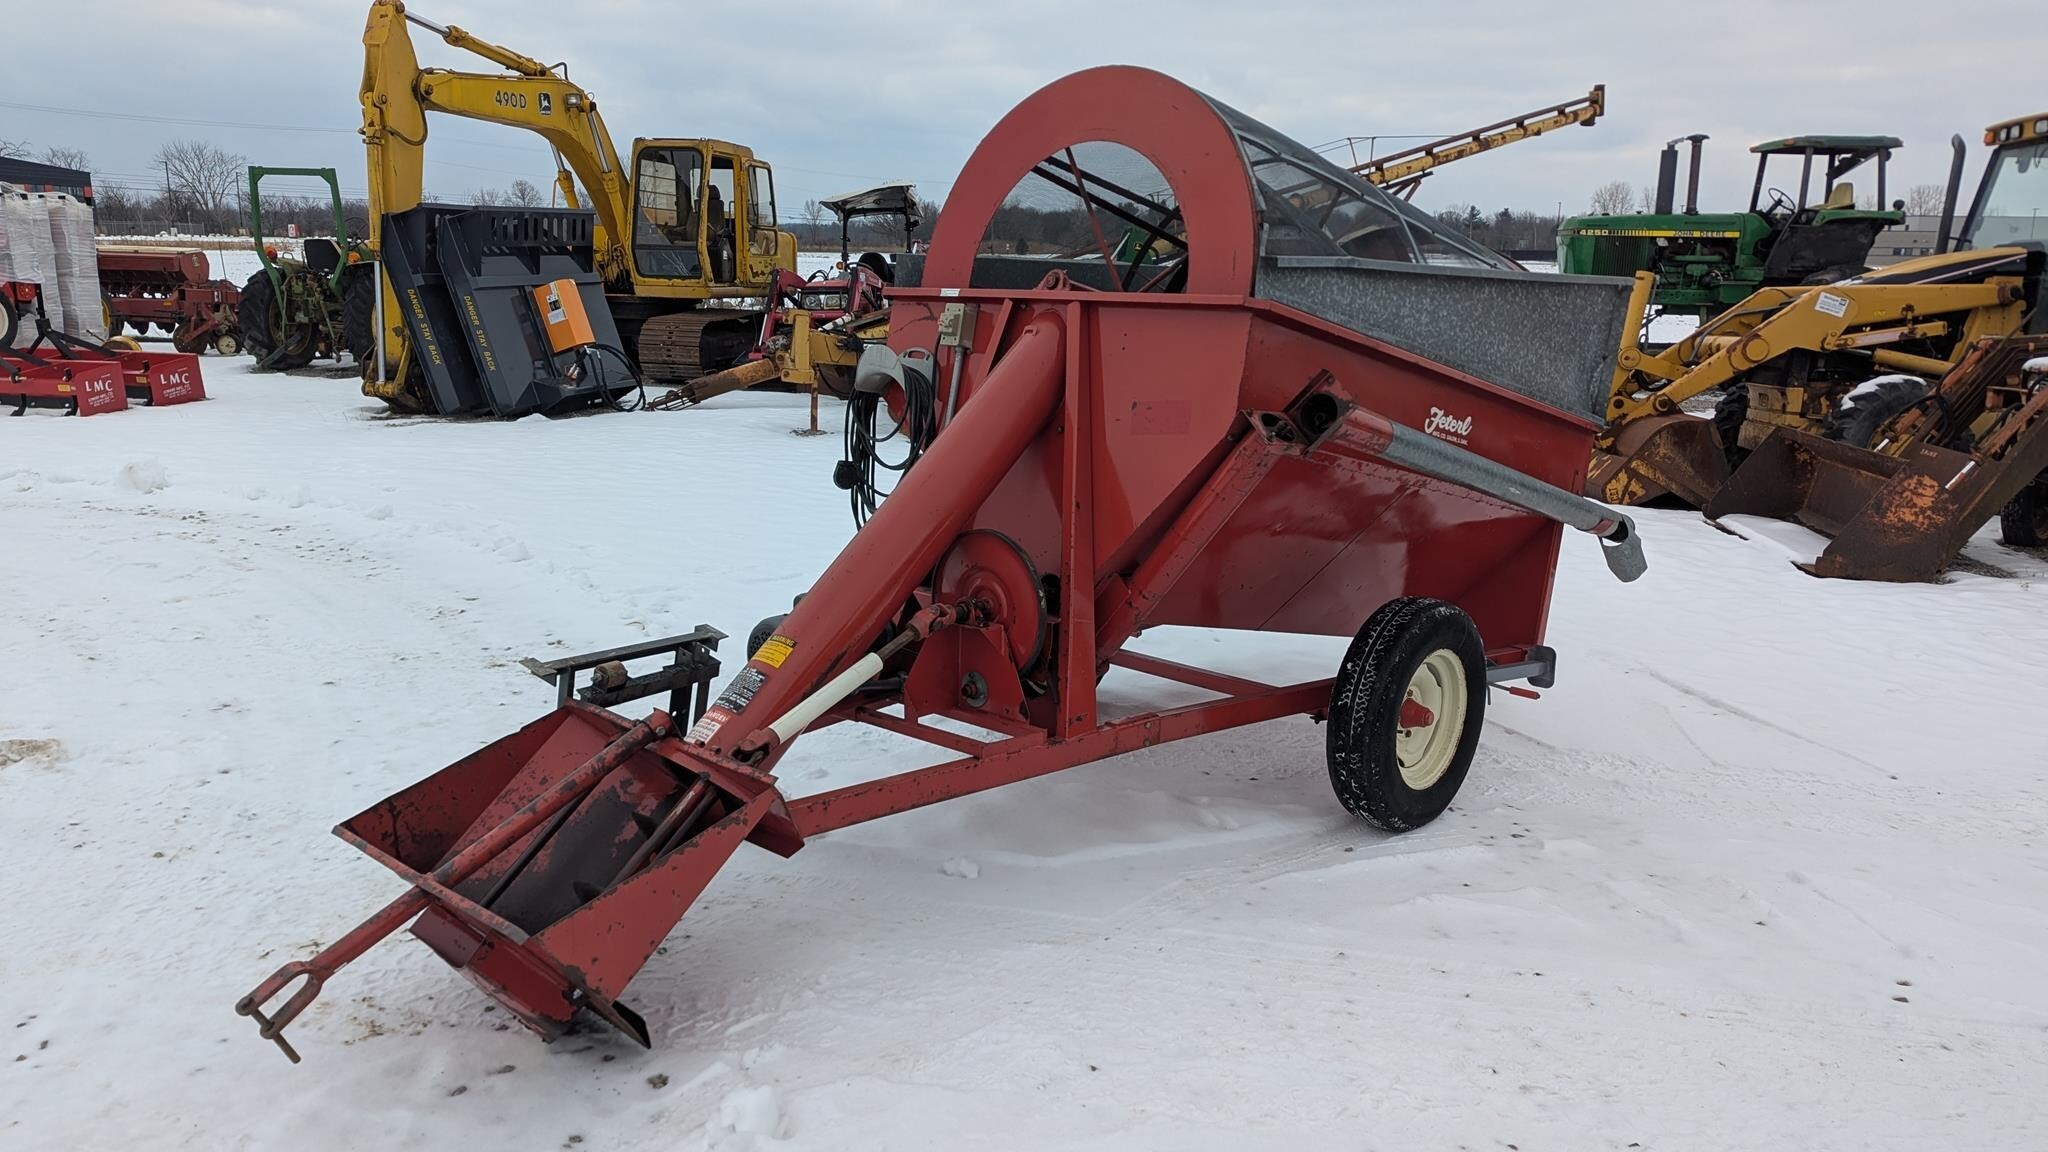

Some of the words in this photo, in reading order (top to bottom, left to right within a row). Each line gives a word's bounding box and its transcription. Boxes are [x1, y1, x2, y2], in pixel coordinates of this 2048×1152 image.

[495, 90, 527, 109] 490D
[1673, 230, 1694, 238] JOHN
[407, 288, 424, 320] DANGER
[420, 323, 433, 341] STAY
[428, 344, 442, 365] BACK
[463, 295, 480, 326] DANGER
[476, 329, 488, 348] STAY
[483, 351, 497, 371] BACK
[85, 380, 113, 393] LMC
[160, 373, 190, 385] LMC
[1424, 406, 1472, 436] Feterl
